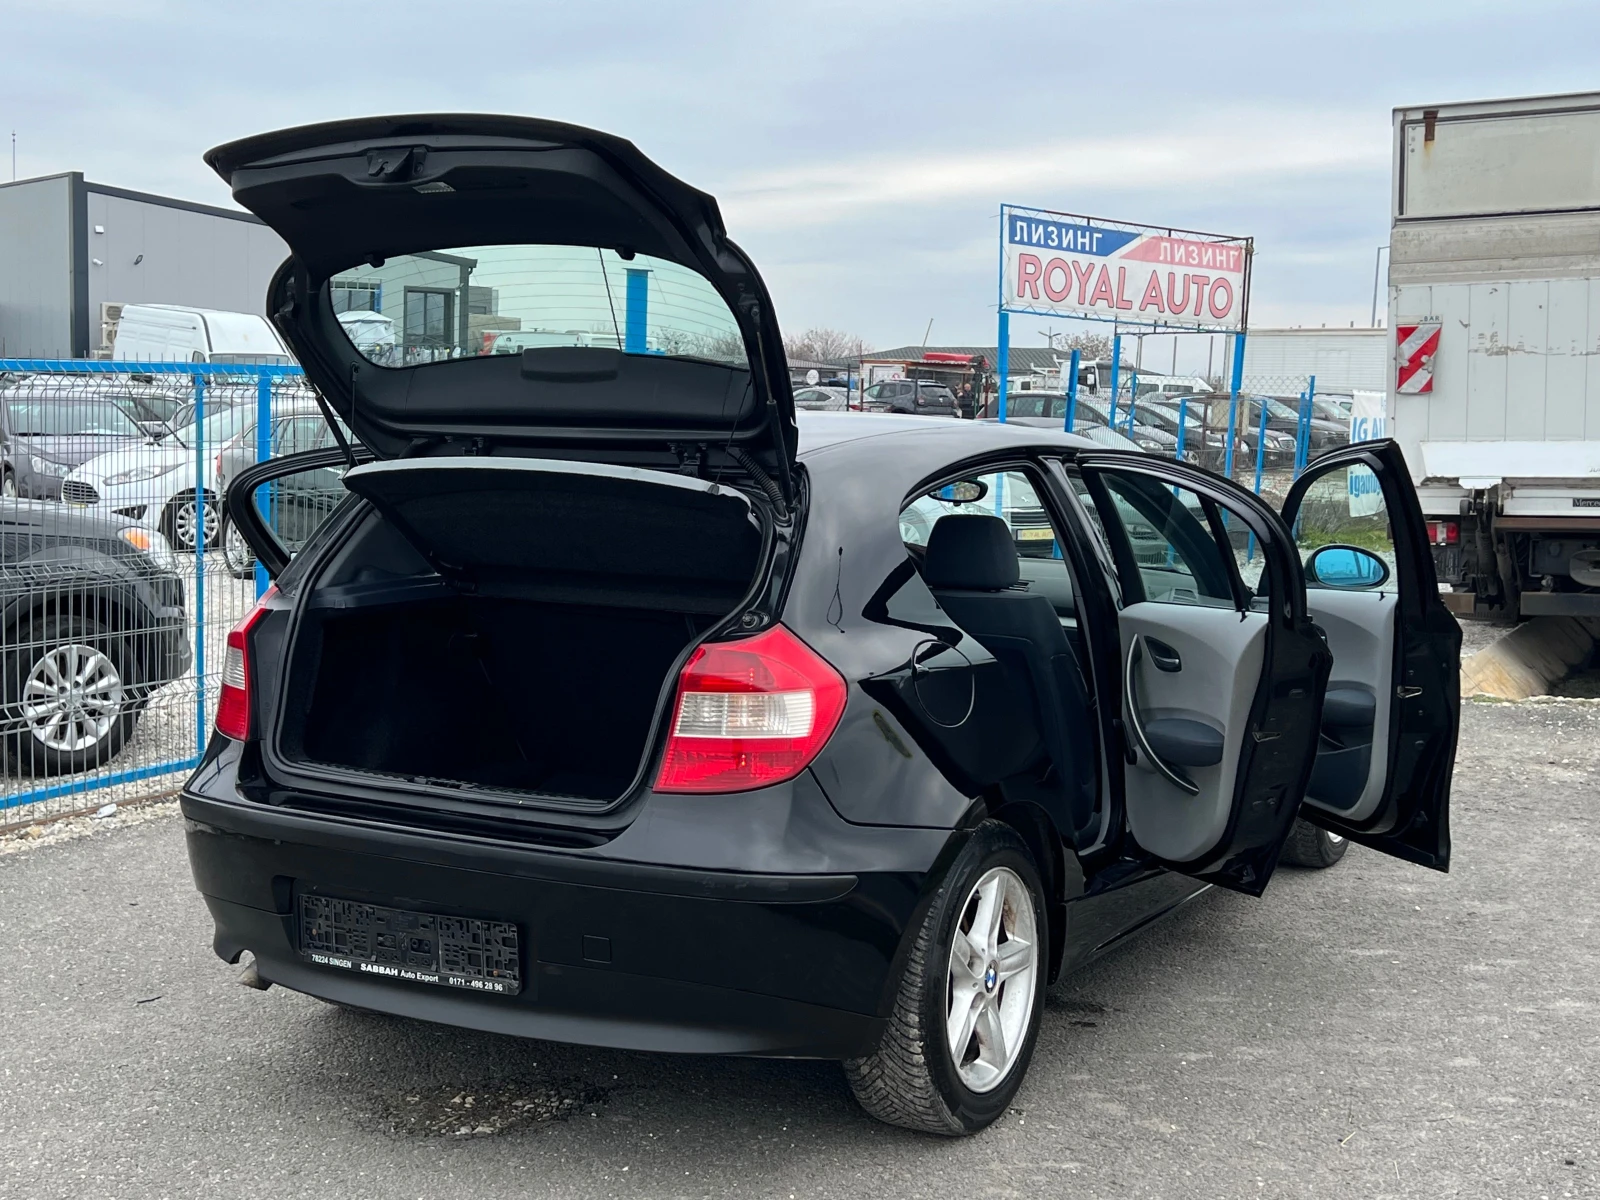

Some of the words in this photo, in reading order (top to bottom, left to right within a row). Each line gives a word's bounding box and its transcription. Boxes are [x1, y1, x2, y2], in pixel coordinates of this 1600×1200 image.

[1014, 221, 1103, 253] ЛИЗИНГ
[1159, 242, 1238, 268] ЛИЗИНГ
[1017, 253, 1133, 310] ROYAL
[1139, 269, 1233, 319] AUTO
[1351, 416, 1368, 444] IG
[311, 954, 329, 964] 78224
[329, 957, 352, 969] SINGEN
[360, 962, 399, 976] SABBAH
[400, 970, 416, 979] Auto
[416, 972, 439, 983] Export
[449, 976, 465, 986] 0171
[470, 979, 483, 989] 496
[484, 981, 493, 990] 28
[494, 982, 503, 992] 96
